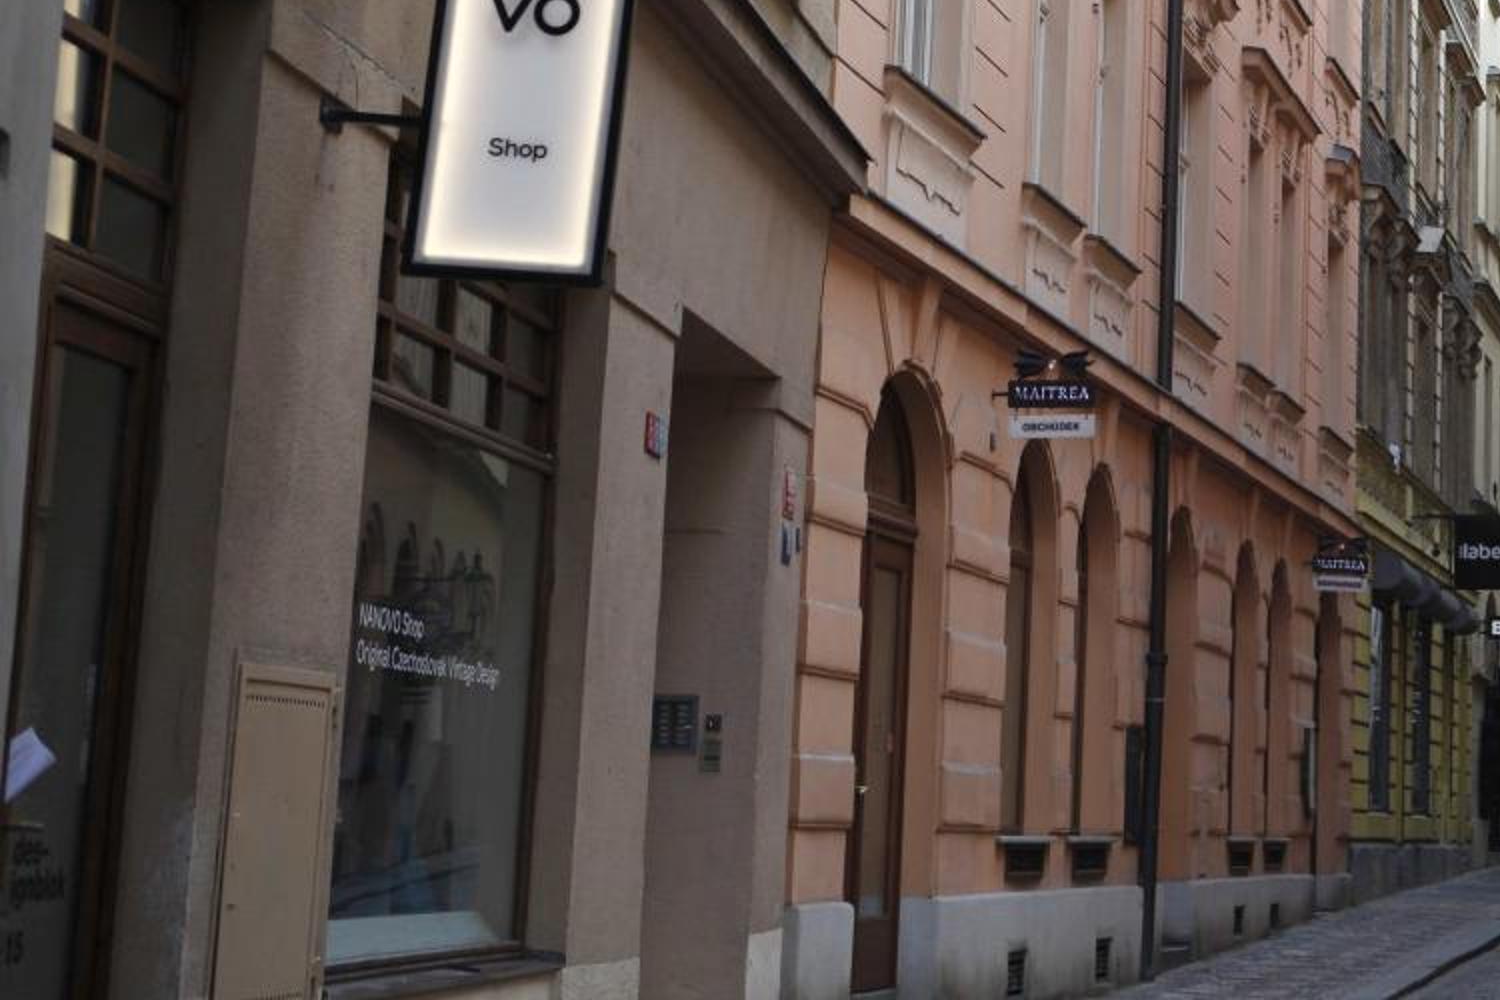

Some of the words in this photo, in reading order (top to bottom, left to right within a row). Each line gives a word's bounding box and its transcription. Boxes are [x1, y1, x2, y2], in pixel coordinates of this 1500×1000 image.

[487, 137, 548, 163] Shop
[1016, 385, 1089, 400] MAITREA
[359, 602, 401, 635] NANOVO
[402, 611, 425, 640] Shop
[356, 638, 391, 672] Original
[391, 646, 448, 678] Czechoslovak
[449, 655, 476, 687] Vintage
[475, 661, 500, 691] Design
